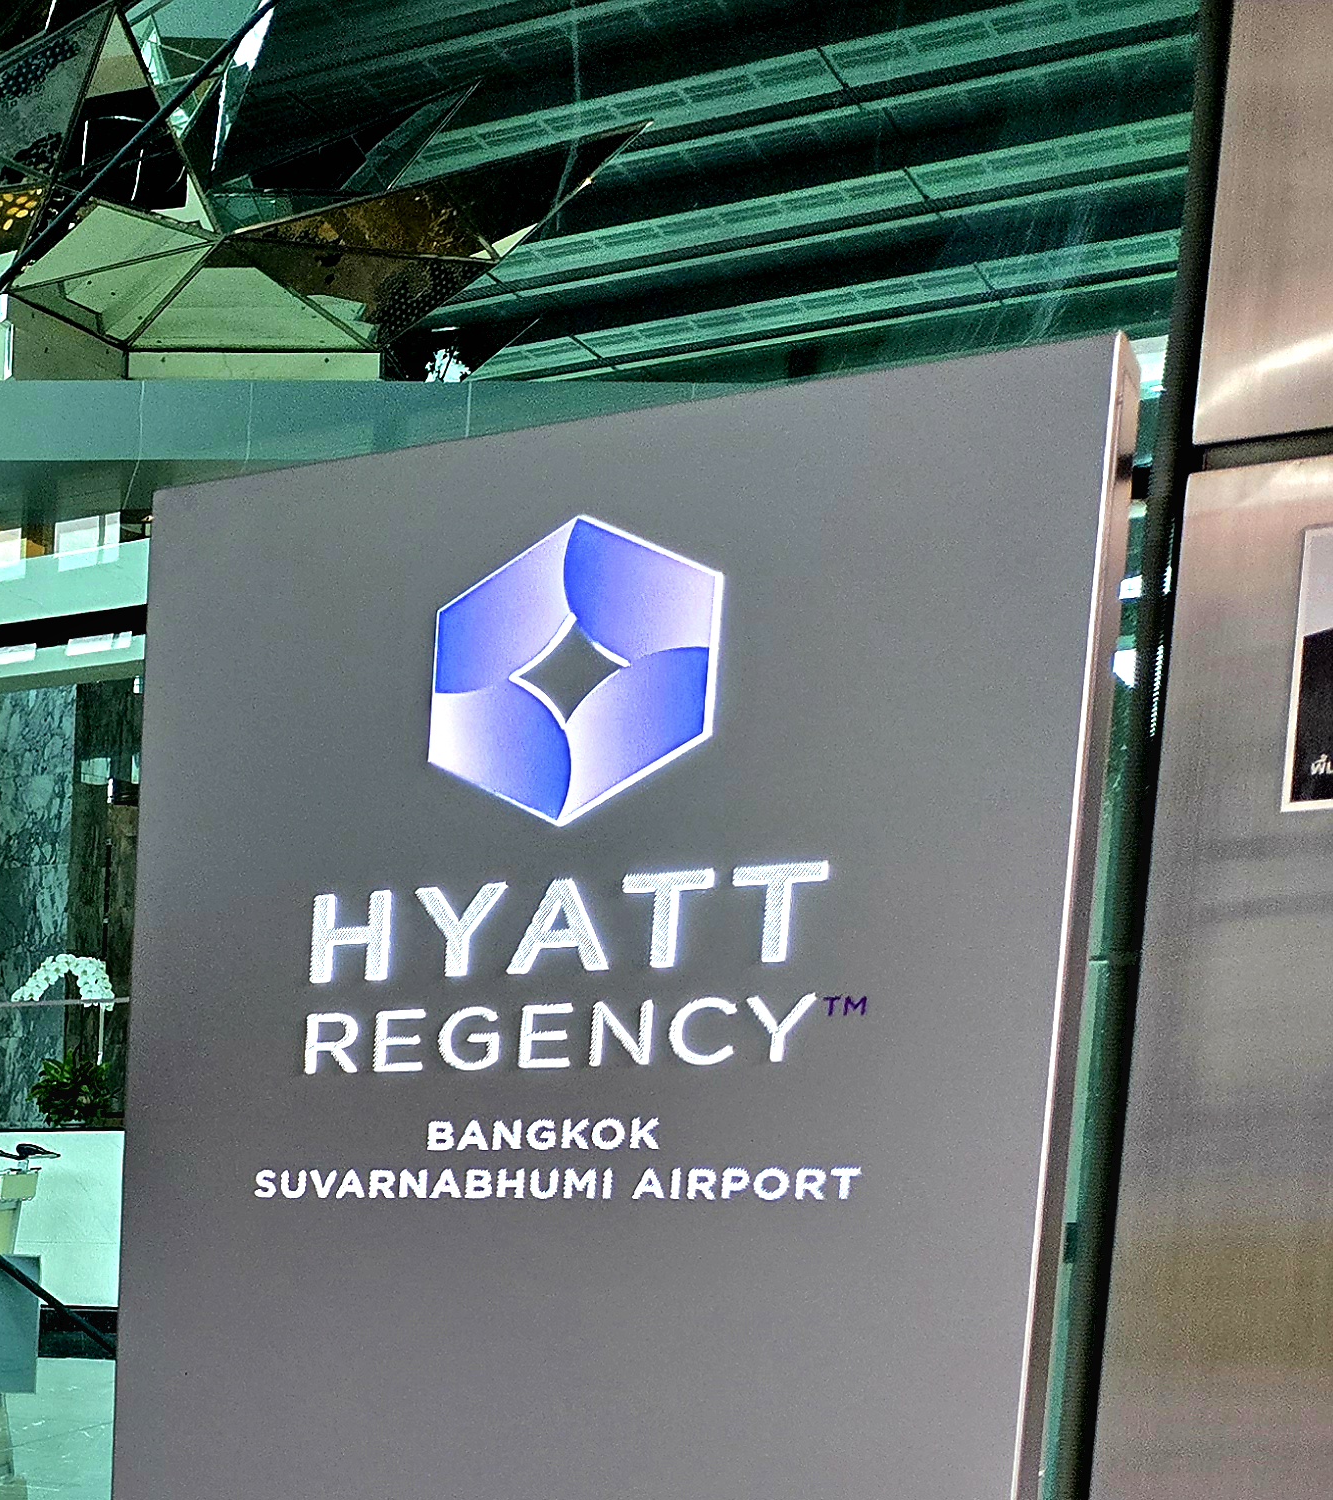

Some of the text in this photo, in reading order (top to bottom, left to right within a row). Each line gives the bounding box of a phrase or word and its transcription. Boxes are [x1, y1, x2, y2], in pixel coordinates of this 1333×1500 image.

[308, 859, 831, 984] HYATT
[303, 991, 819, 1076] REGENCY
[426, 1116, 661, 1152] BANGKOK
[253, 1165, 863, 1201] SUVARNABHUMI AIRPORT
